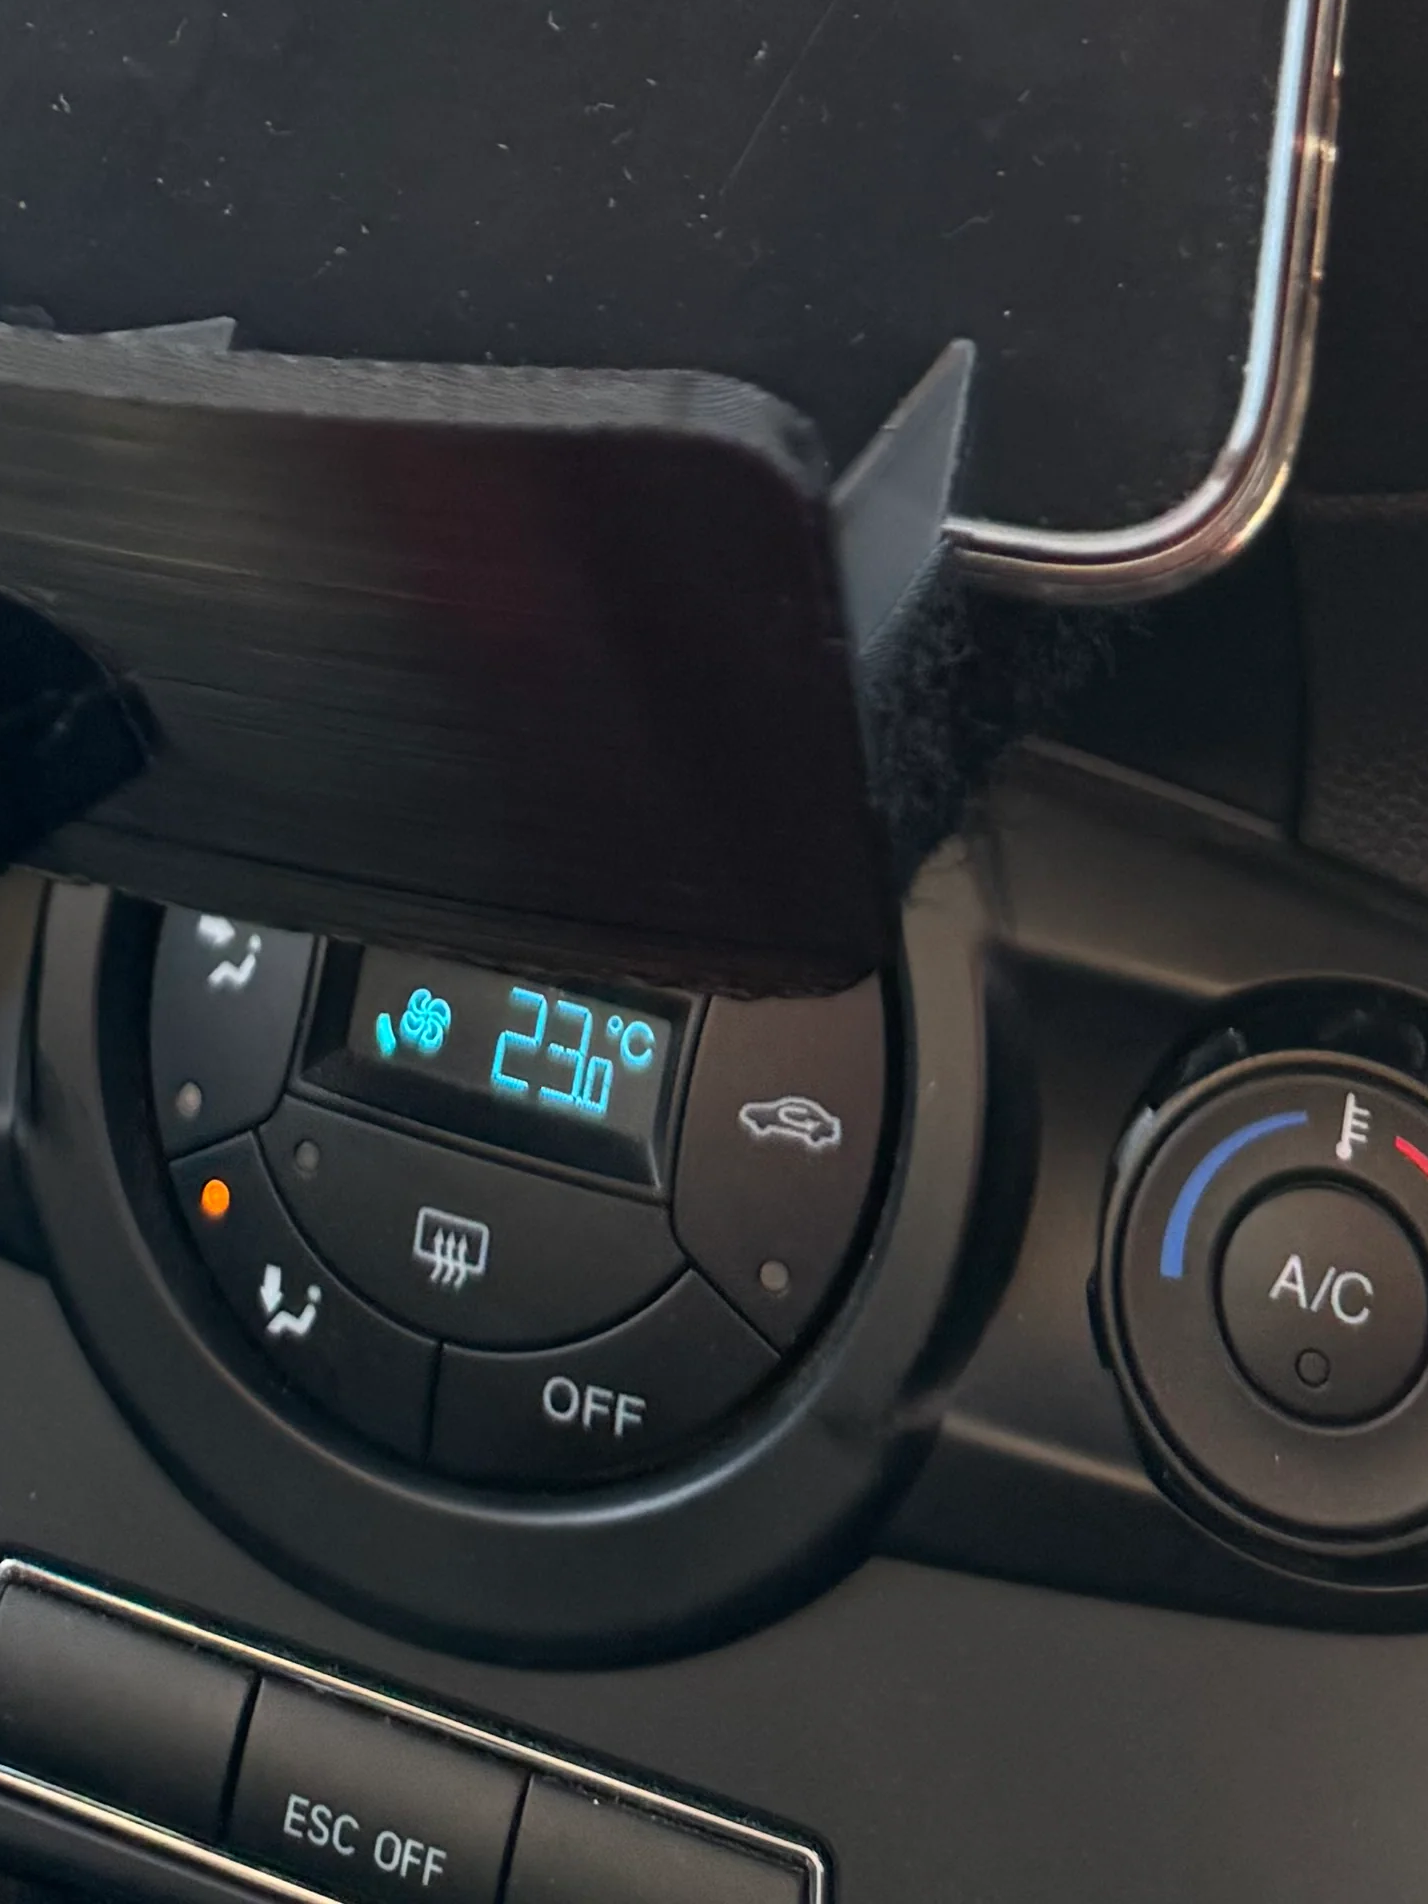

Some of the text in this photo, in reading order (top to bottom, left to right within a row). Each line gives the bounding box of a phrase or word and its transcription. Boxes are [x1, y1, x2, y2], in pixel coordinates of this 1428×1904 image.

[1268, 1252, 1374, 1326] A/C
[541, 1374, 648, 1438] OFF
[282, 1792, 448, 1887] ESC OFF
